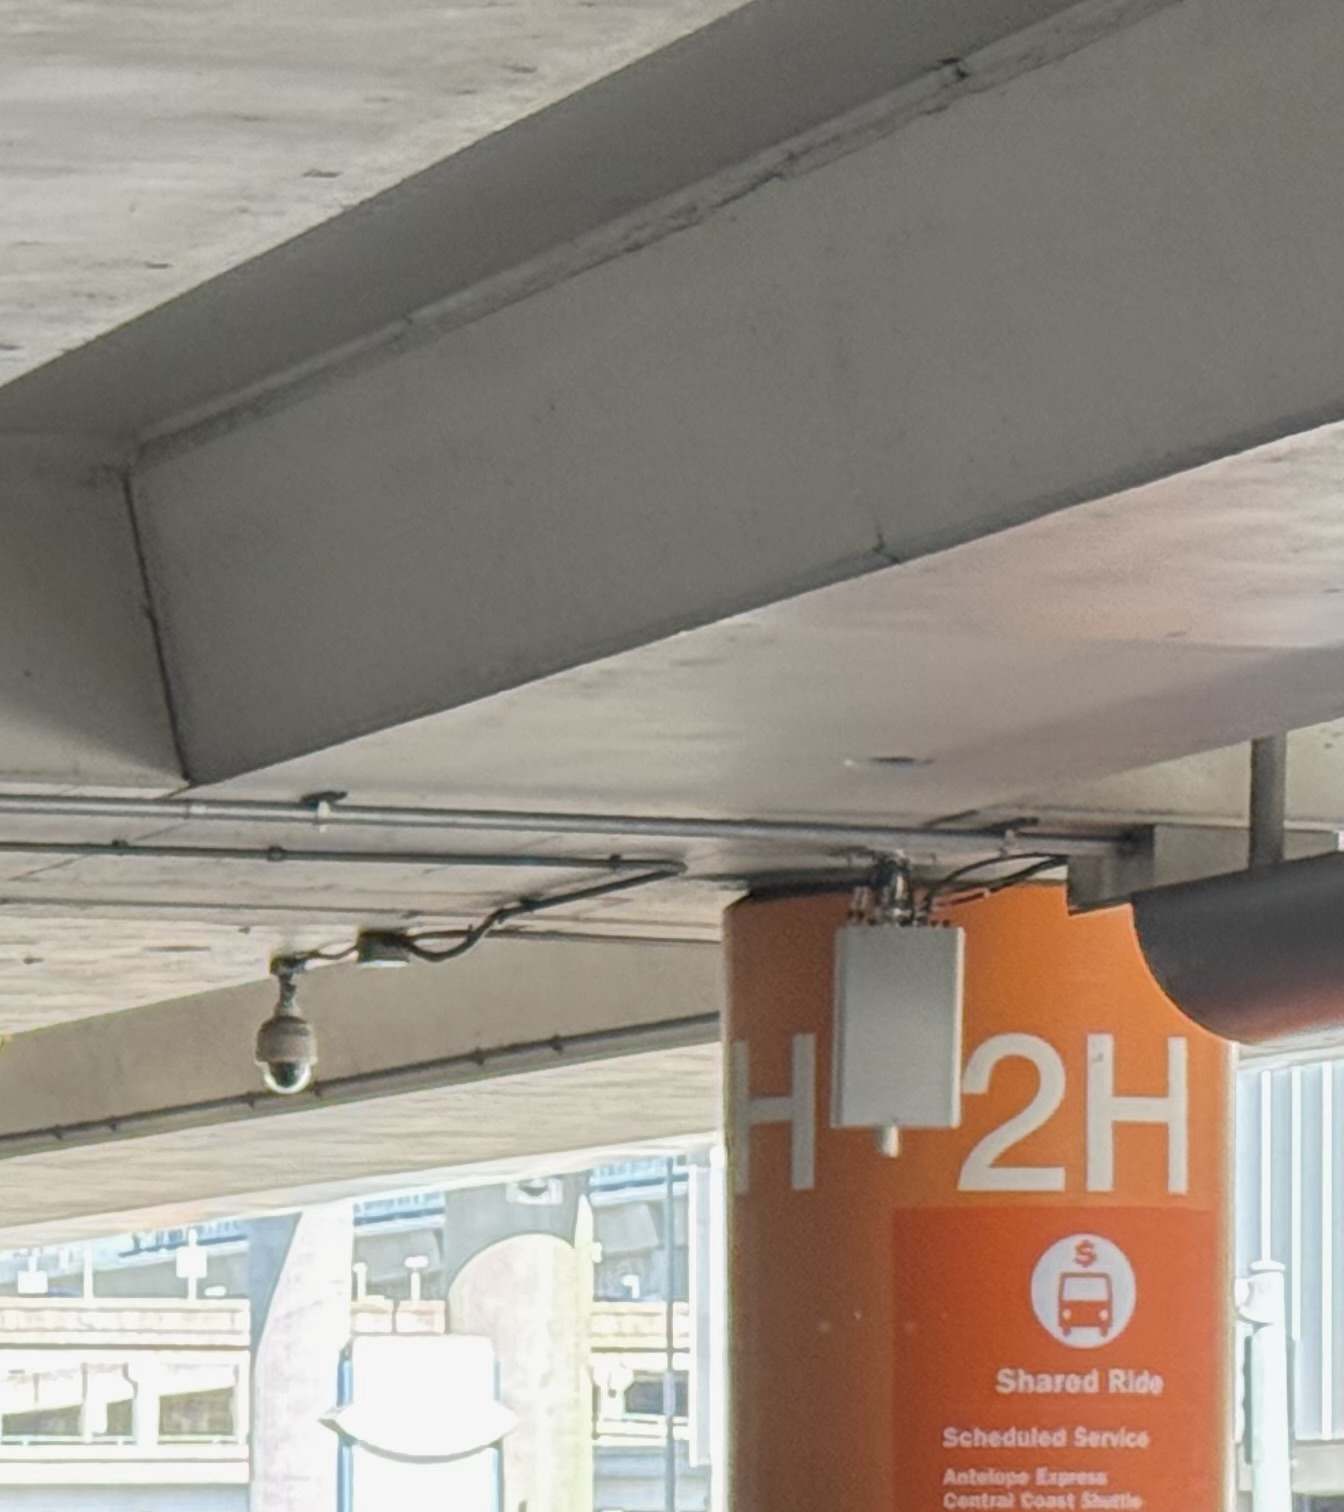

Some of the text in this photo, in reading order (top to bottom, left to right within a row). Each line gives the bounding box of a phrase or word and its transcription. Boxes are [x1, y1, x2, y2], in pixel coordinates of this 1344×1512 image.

[957, 1032, 1189, 1195] 2H
[996, 1368, 1164, 1395] Shared Ride
[943, 1427, 1150, 1449] Scheduled Service
[944, 1468, 1109, 1488] Antelope Express
[944, 1493, 1143, 1511] Central Coast Shuttle
